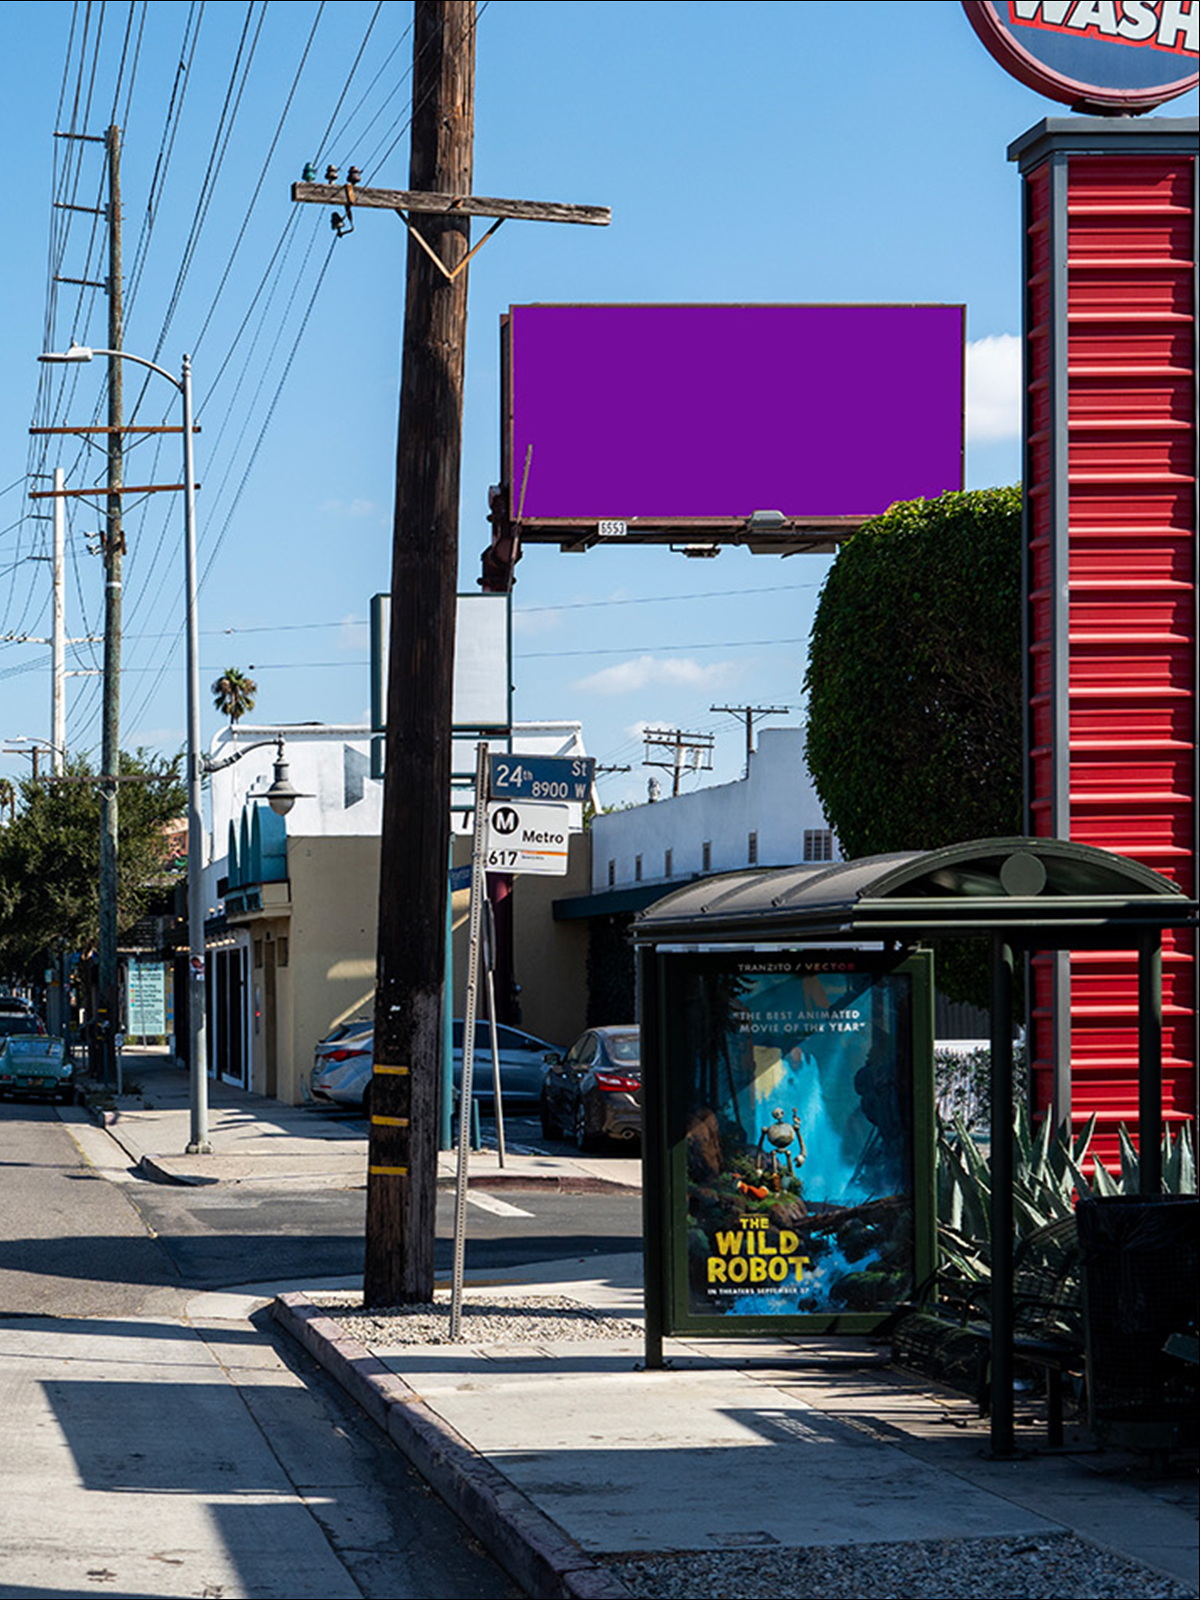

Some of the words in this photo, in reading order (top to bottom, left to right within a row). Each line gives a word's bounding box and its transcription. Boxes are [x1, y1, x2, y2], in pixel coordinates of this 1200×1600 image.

[496, 764, 533, 787] 24th
[571, 760, 587, 777] St
[531, 781, 568, 798] 8900
[574, 784, 586, 798] W
[522, 830, 564, 844] Metro
[488, 850, 518, 866] 617
[738, 963, 792, 972] TRANZITO
[805, 962, 855, 971] VECTOR
[766, 1011, 793, 1020] BEST
[798, 1010, 860, 1020] ANIMATED
[740, 1023, 779, 1033] MOVIE
[783, 1023, 799, 1032] OF
[803, 1023, 825, 1032] THE
[740, 1217, 770, 1230] THE
[715, 1230, 799, 1255] WILD
[707, 1256, 810, 1283] ROBOT
